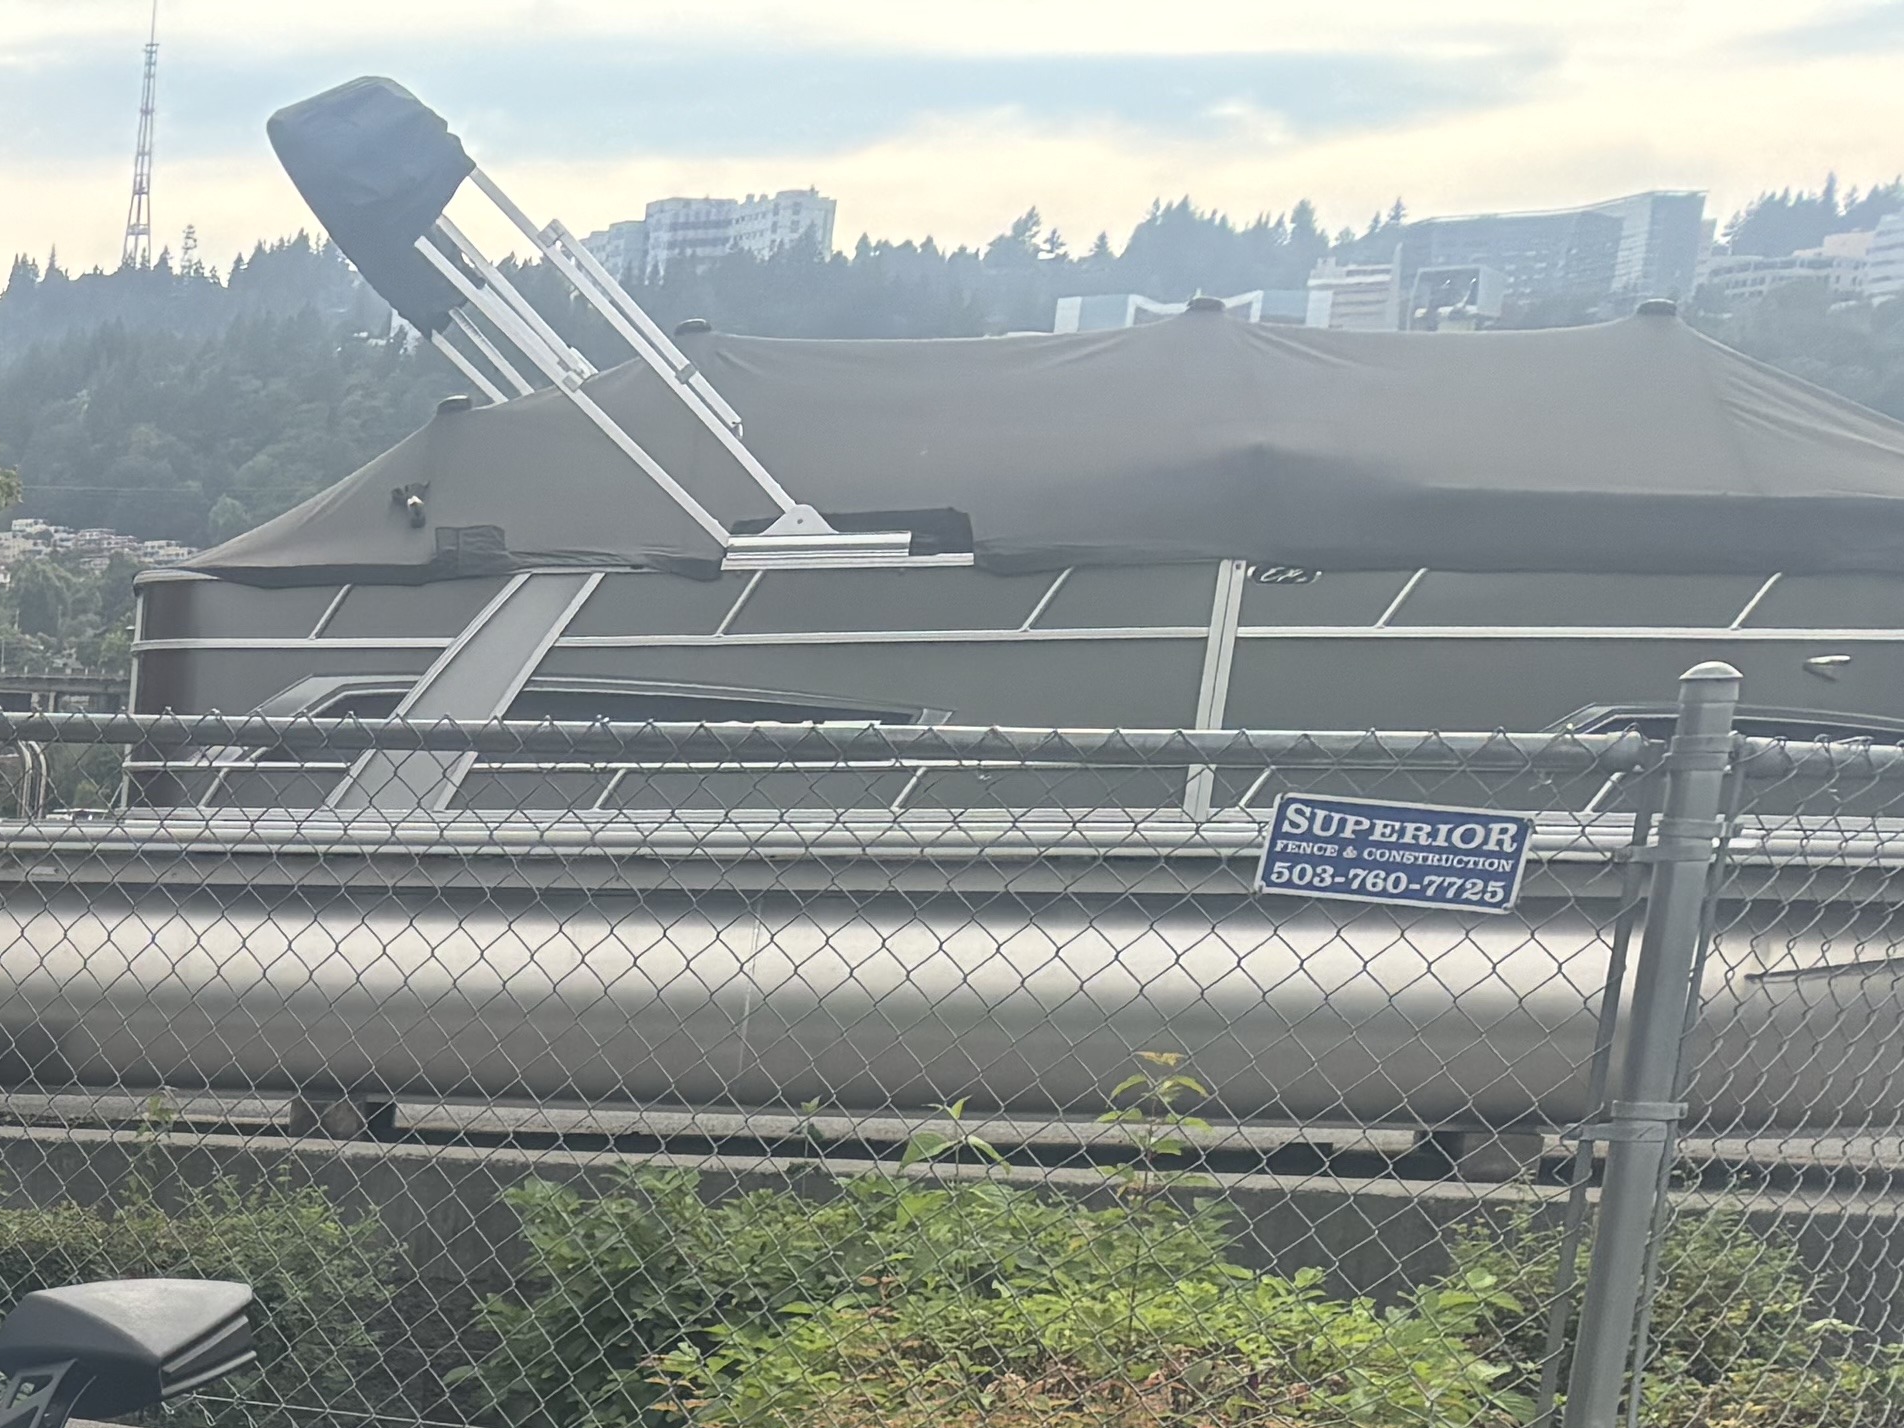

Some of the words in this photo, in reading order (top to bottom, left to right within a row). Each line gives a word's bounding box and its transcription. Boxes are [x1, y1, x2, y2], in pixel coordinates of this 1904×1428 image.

[1281, 802, 1518, 853] SUPERIOR
[1274, 839, 1339, 858] FENCE
[1342, 845, 1358, 859] &
[1362, 848, 1515, 873] CONSTRUCTION
[1270, 861, 1506, 903] 503-760-7725
